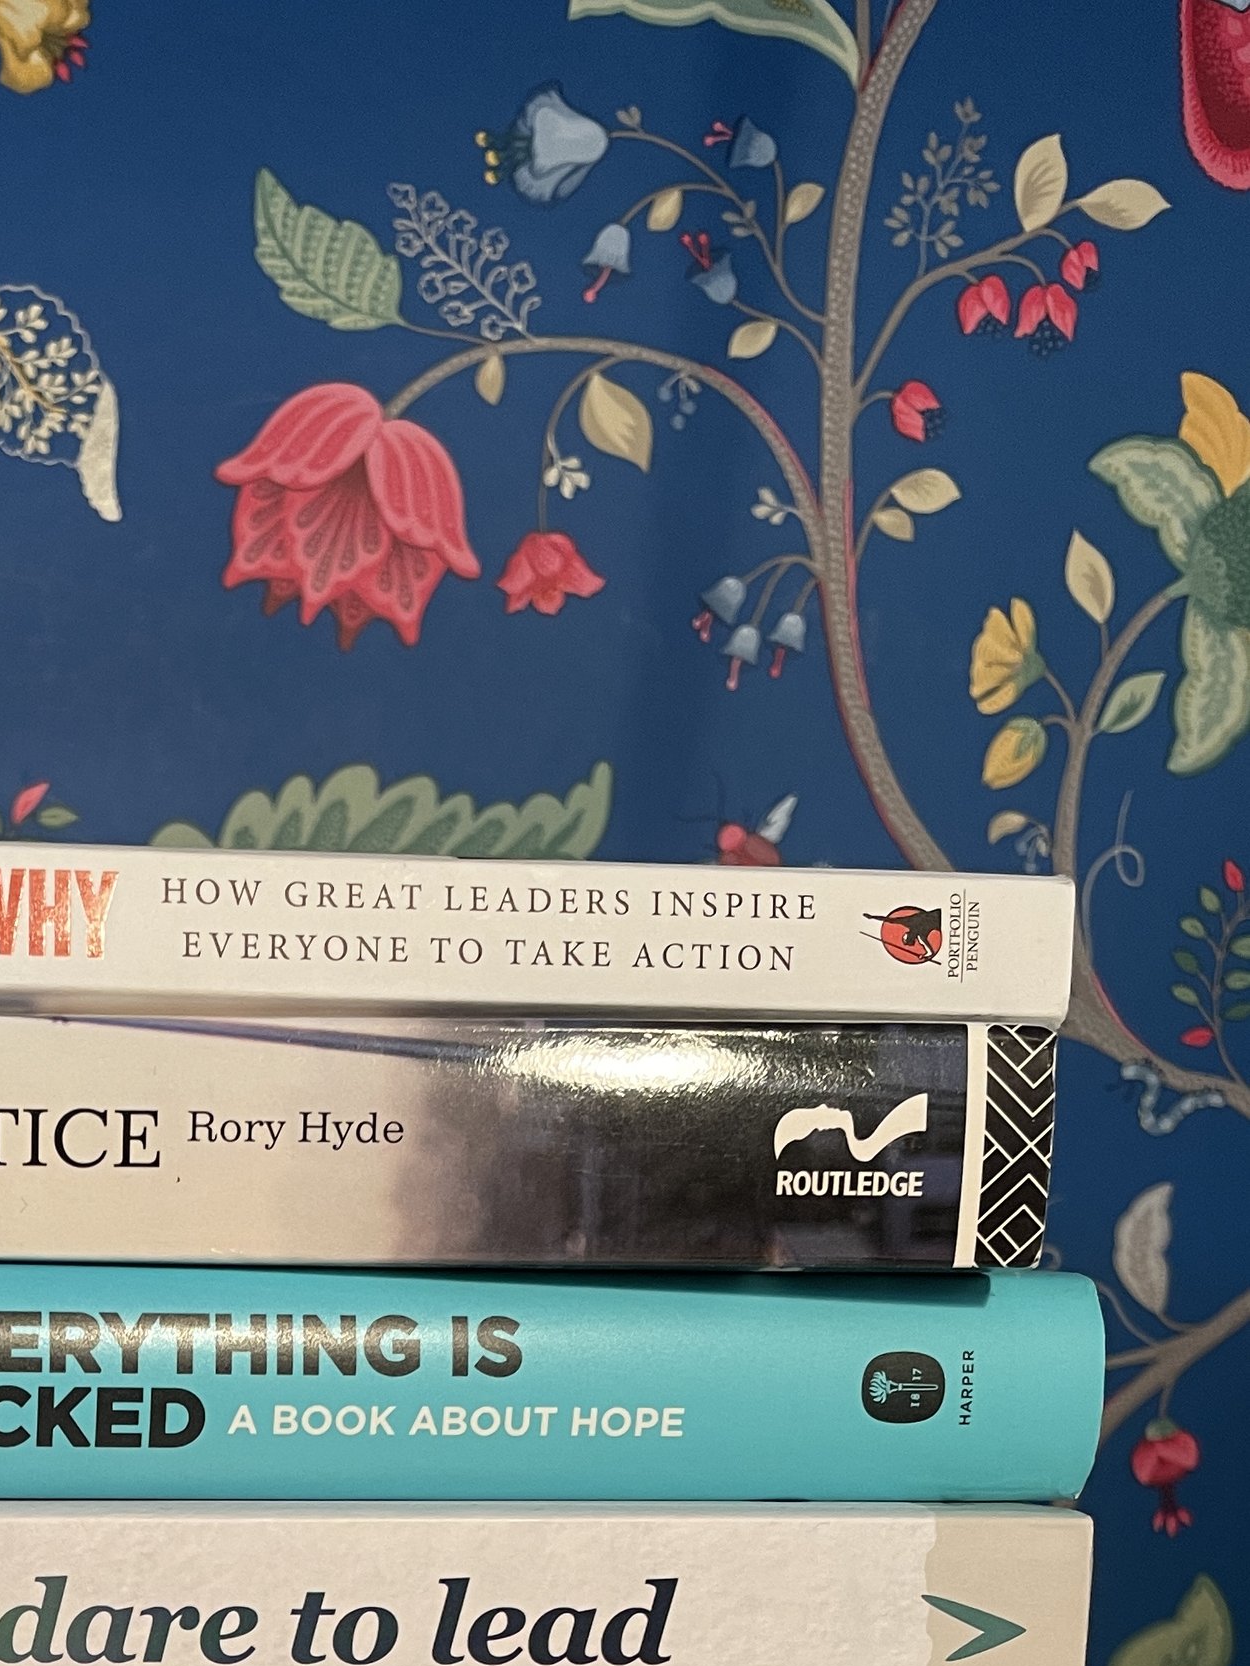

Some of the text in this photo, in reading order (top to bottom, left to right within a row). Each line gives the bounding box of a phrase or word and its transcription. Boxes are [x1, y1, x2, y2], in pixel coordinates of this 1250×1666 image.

[161, 877, 818, 921] HOW GREAT LEADERS INSPIRE
[182, 930, 795, 972] EVERYONE TO TAKE ACTION
[947, 893, 962, 979] PORTFOLIO
[965, 900, 981, 971] PENGUIN
[186, 1110, 404, 1154] Rory Hyde
[776, 1169, 925, 1196] ROUTLEDGE
[452, 1314, 523, 1378] IS
[958, 1349, 975, 1426] HARPER
[228, 1404, 686, 1438] A BOOK ABOUT HOPE
[291, 1591, 399, 1666] to
[432, 1577, 681, 1666] lead
